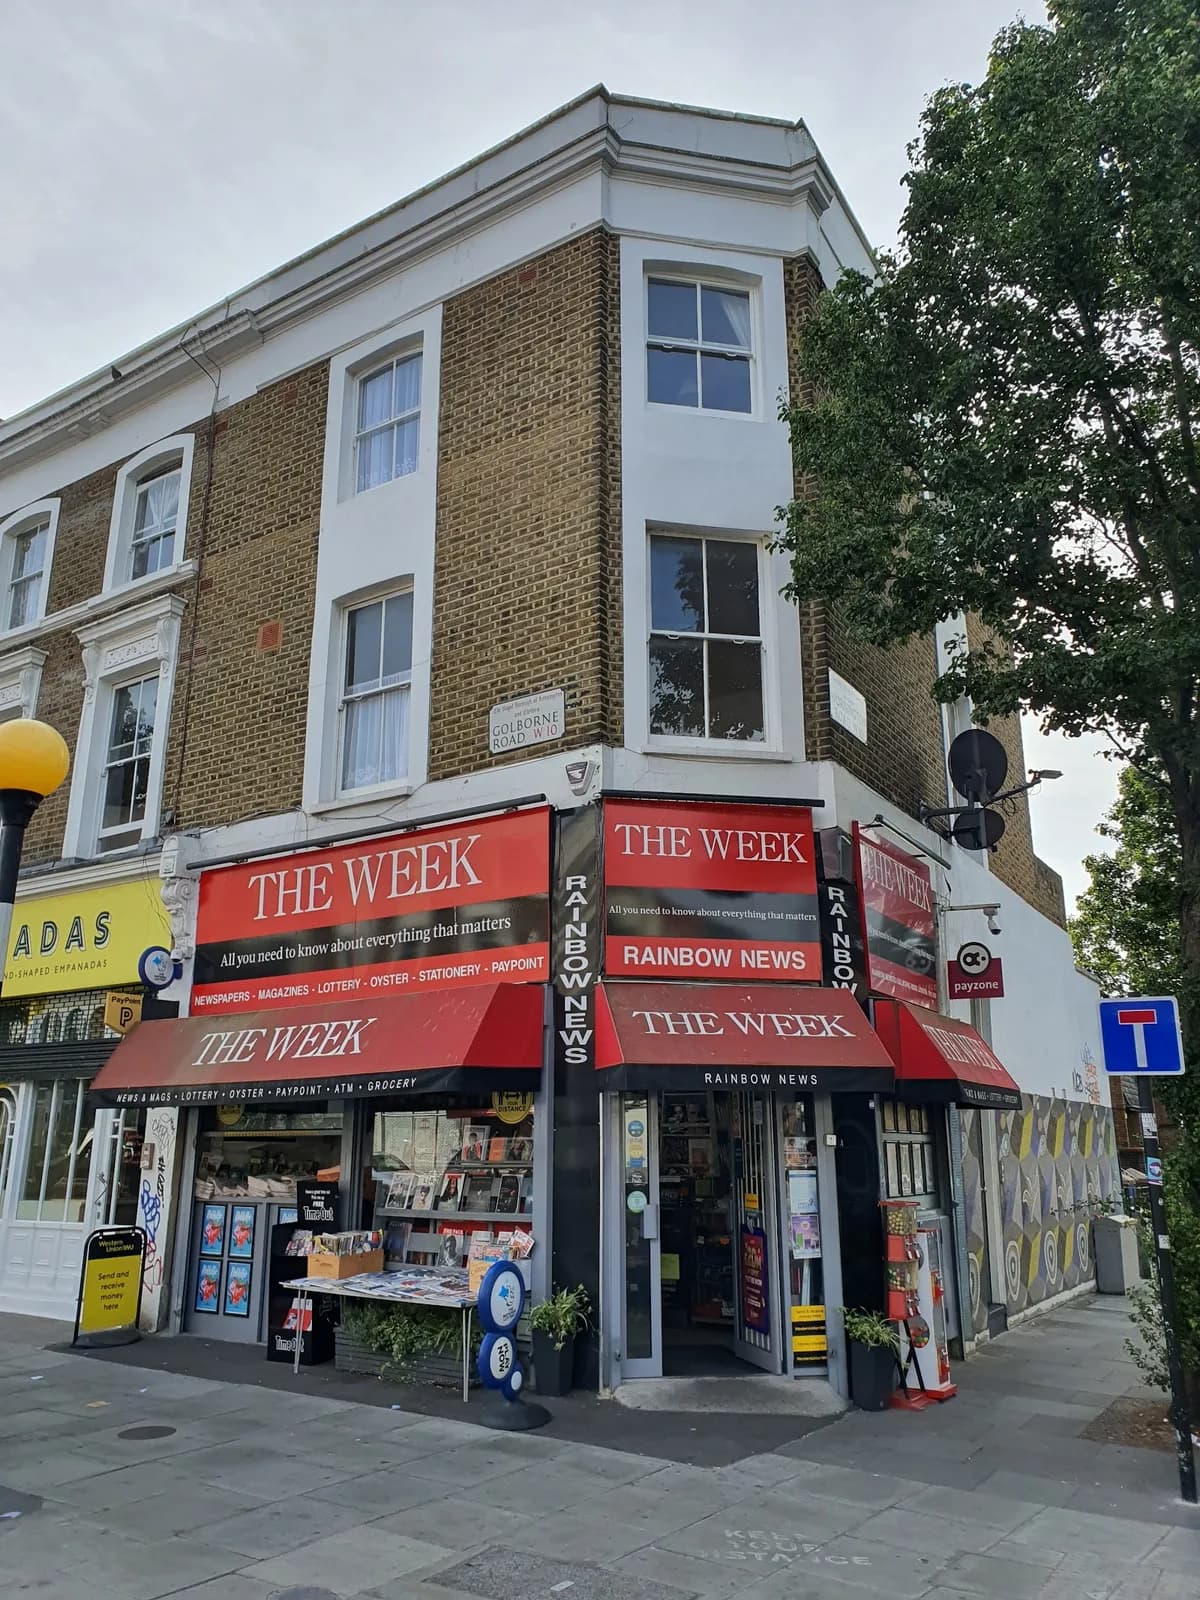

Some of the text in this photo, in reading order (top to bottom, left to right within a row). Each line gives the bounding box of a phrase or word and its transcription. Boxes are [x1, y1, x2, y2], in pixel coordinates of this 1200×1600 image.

[492, 711, 558, 736] GOLBORNE
[493, 732, 526, 750] ROAD
[614, 823, 809, 865] THE WEEK
[248, 833, 482, 920] THE WEEK
[893, 862, 932, 912] WEEK
[608, 906, 817, 922] All you need to know about everything that matters
[220, 916, 512, 968] All you need to know about everything that matters
[560, 875, 592, 989] RAINBOW
[54, 960, 108, 974] EMPANADAS
[623, 946, 806, 970] RAINBOW NEWS
[194, 956, 544, 1006] NEWSPAPERS MAGAZINES LOTTERY OYSTER STATIONERY PAYPOINT
[954, 982, 999, 994] payzone
[112, 996, 140, 1004] PayPoint
[560, 995, 592, 1064] NEWS
[632, 1010, 857, 1038] THE WEEK
[192, 1017, 379, 1066] THE WEEK
[116, 1077, 417, 1103] NEWS & MAGS LOTTERY OYSTER PAYPOINT ATM GROCERY
[704, 1072, 818, 1086] RAINBOW NEWS
[98, 1270, 130, 1280] Send and
[100, 1282, 126, 1290] receive
[100, 1294, 124, 1302] money
[104, 1303, 119, 1312] here
[497, 1346, 505, 1372] NOW
